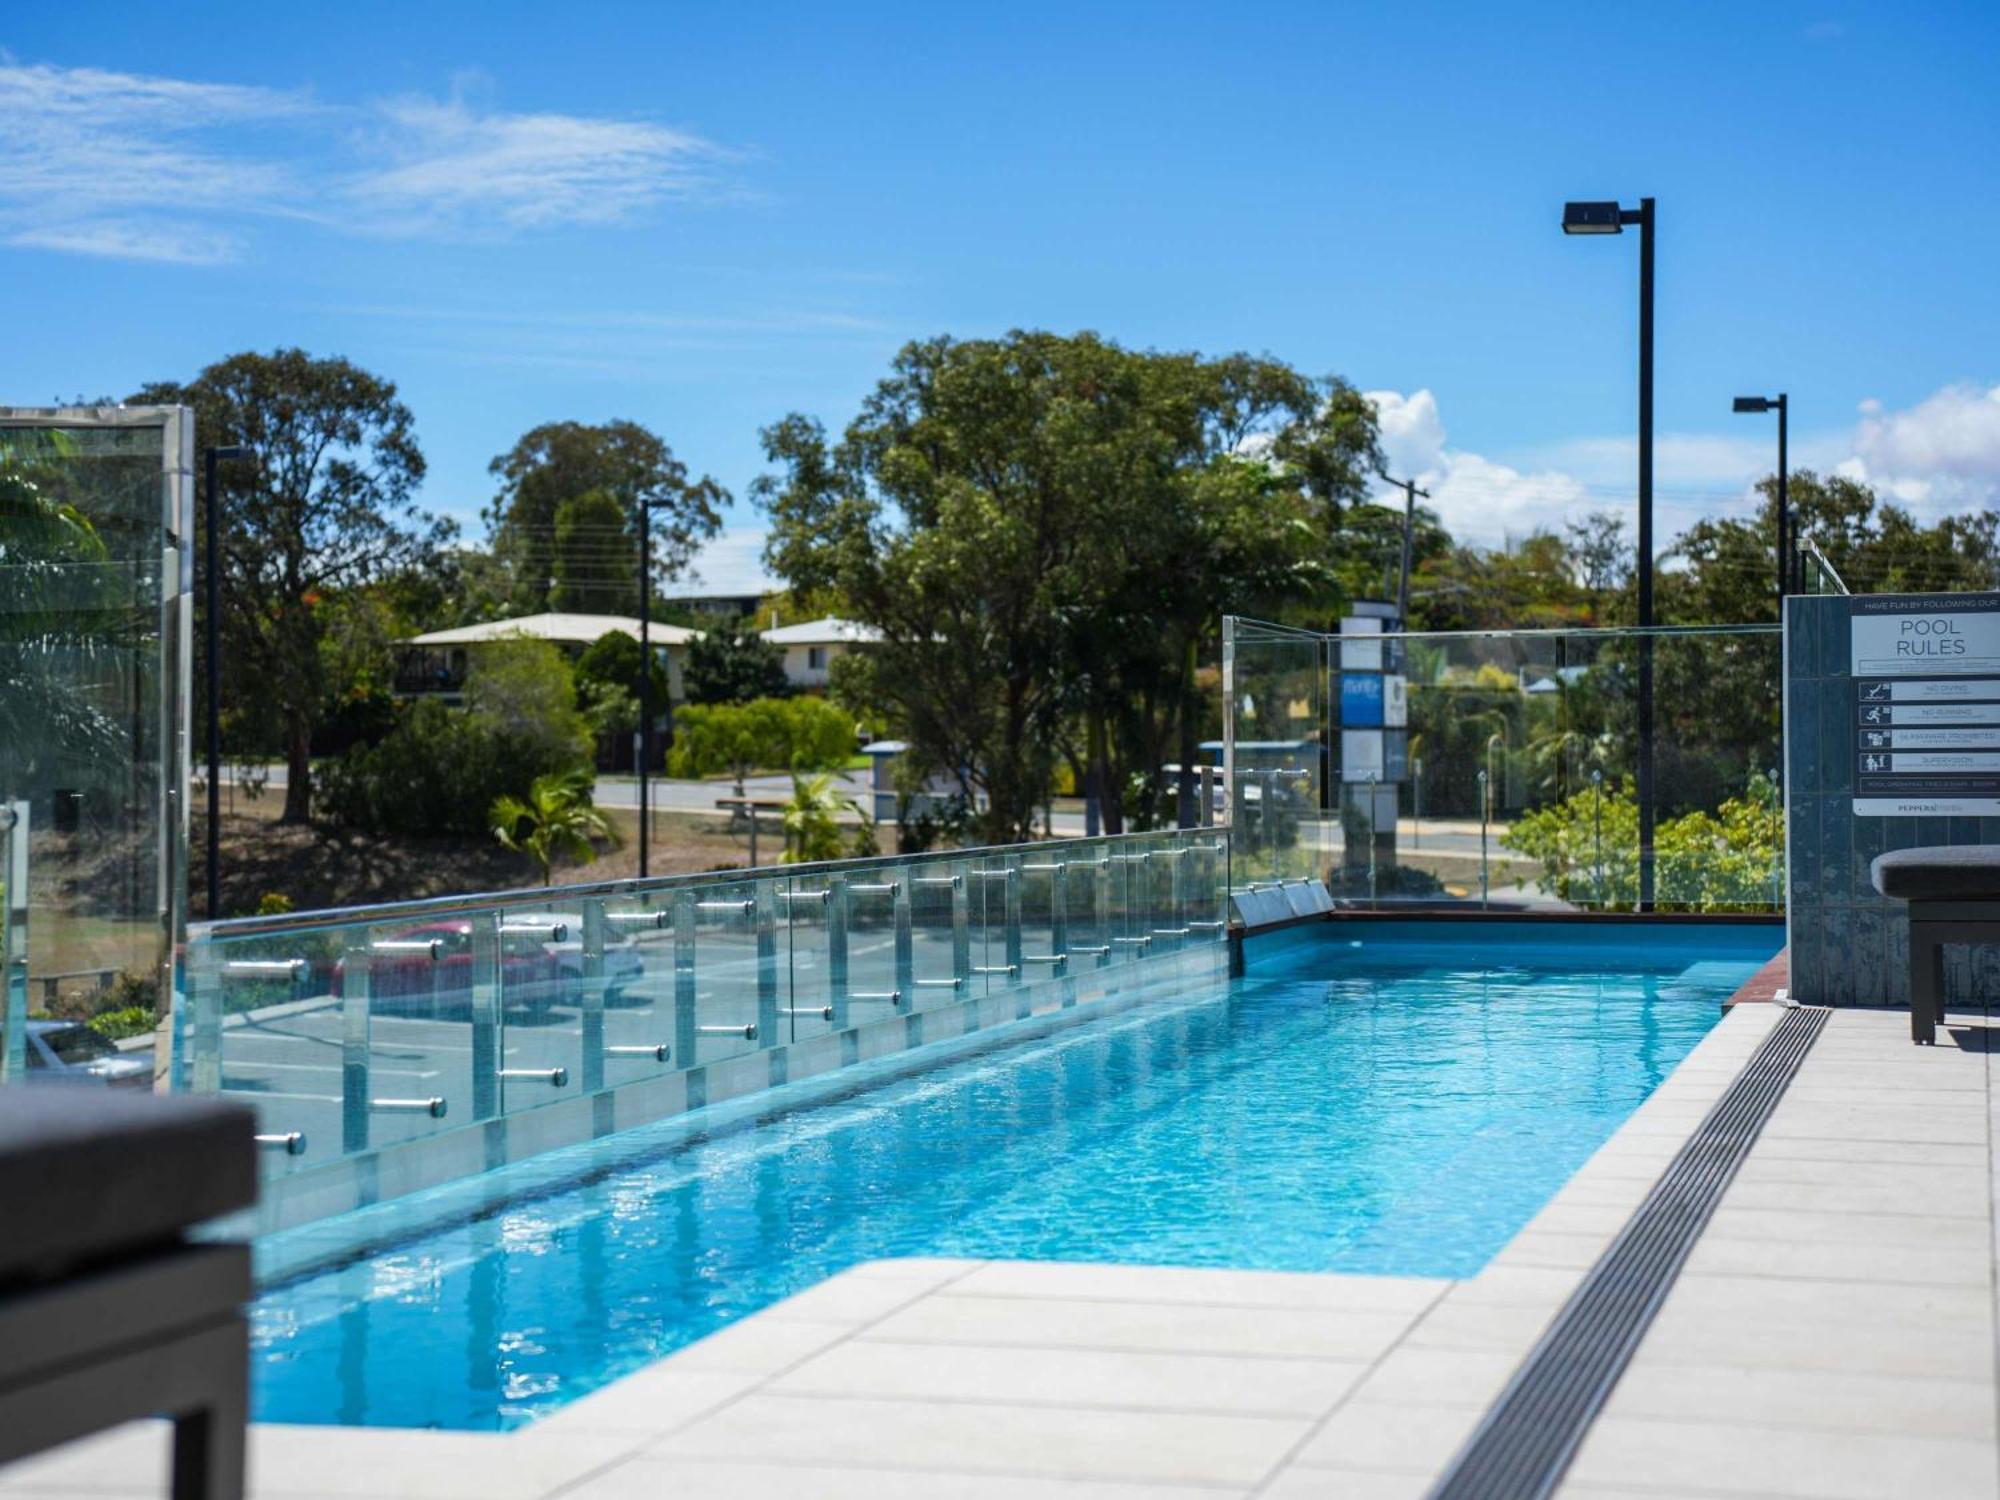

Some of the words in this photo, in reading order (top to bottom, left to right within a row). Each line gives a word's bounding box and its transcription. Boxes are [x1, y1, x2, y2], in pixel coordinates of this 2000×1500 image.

[1923, 600, 1975, 608] FOLLOWING
[1900, 619, 1962, 635] POOL
[1897, 639, 1965, 656] RULES
